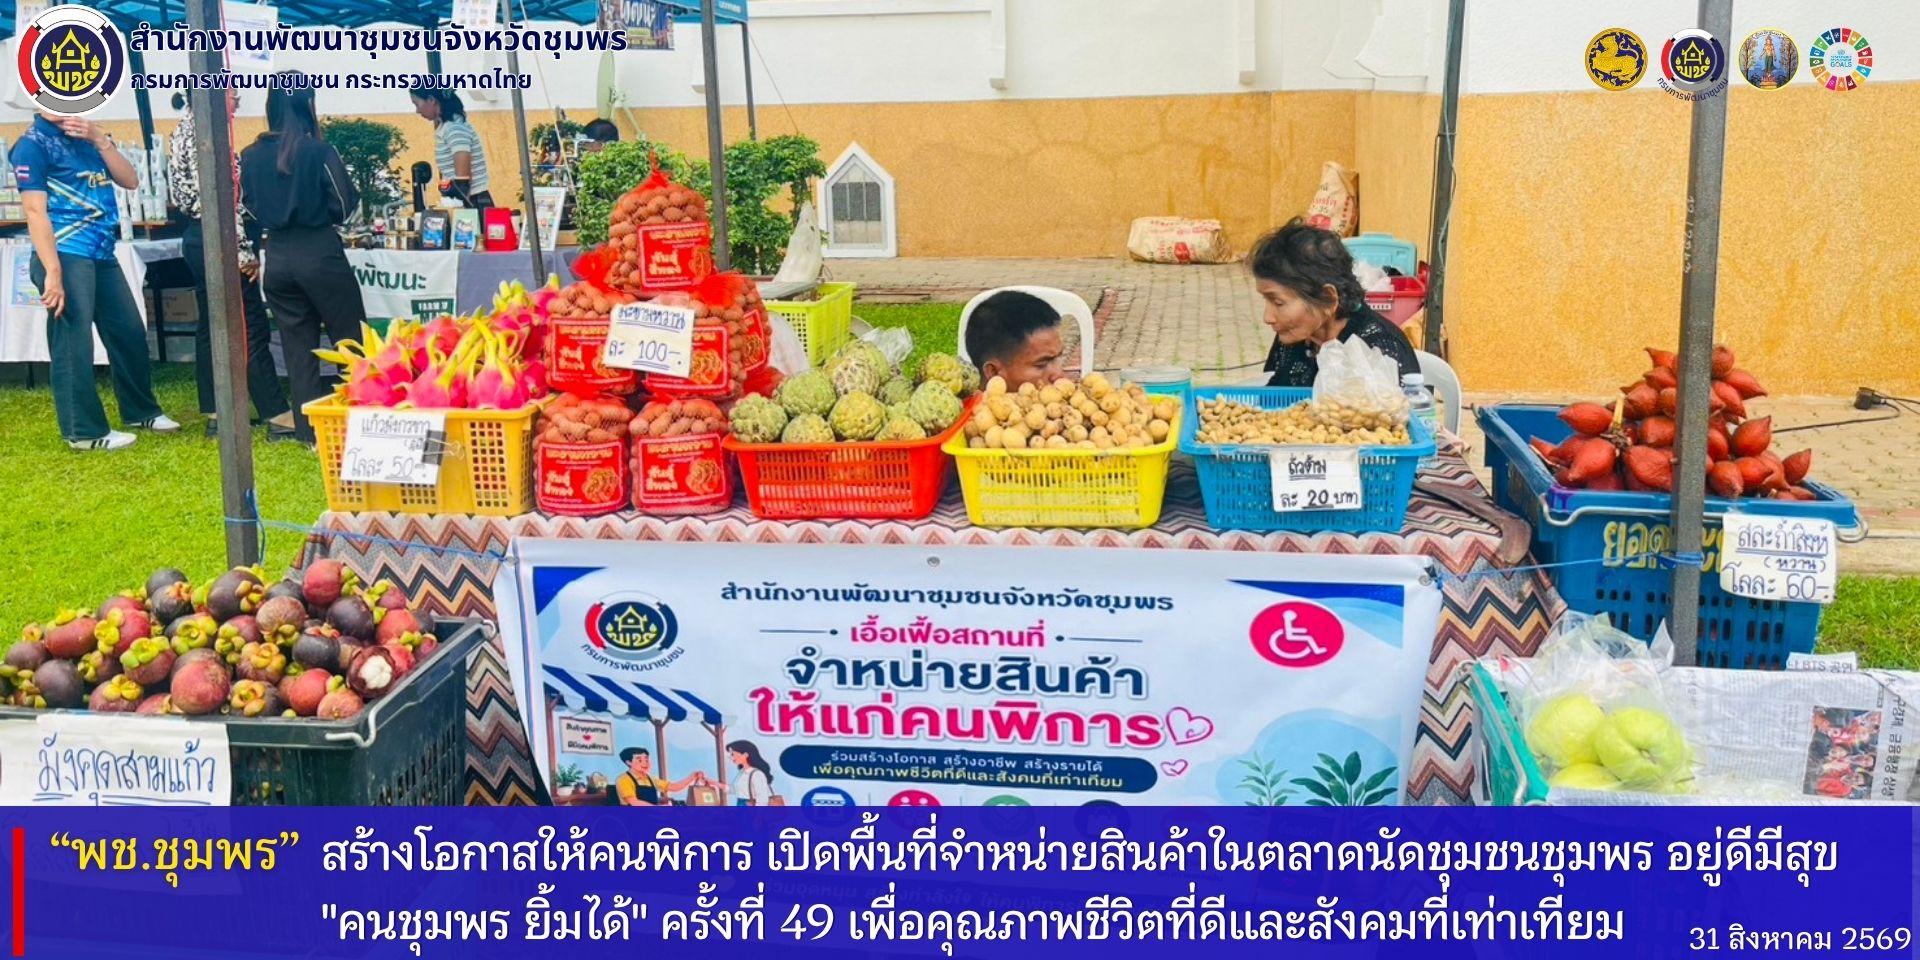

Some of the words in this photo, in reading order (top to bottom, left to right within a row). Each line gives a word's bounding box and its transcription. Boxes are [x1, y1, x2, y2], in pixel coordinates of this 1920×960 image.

[351, 262, 427, 291] พัฒนะ
[1307, 489, 1330, 507] 20
[1333, 491, 1358, 505] บาท
[1721, 561, 1776, 595] โลละ
[721, 581, 1174, 614] สำนักงานพัฒนาชุมชนจังหวัดชุมพร
[850, 615, 1046, 648] เอื้อเฟื้อสถานที่
[580, 643, 685, 673] กรมการพัฒนาชุมชน
[785, 645, 1145, 697] จำหน่ายสินค้า
[1802, 660, 1826, 672] BTS
[748, 687, 1163, 746] ให้แก่คนพิการ
[38, 732, 217, 806] มังคุดสามแก้ว
[831, 750, 937, 766] ร่วมสร้างโอกาส
[943, 753, 1018, 769] สร้างอาชีพ
[1024, 756, 1103, 773] สร้างรายได้
